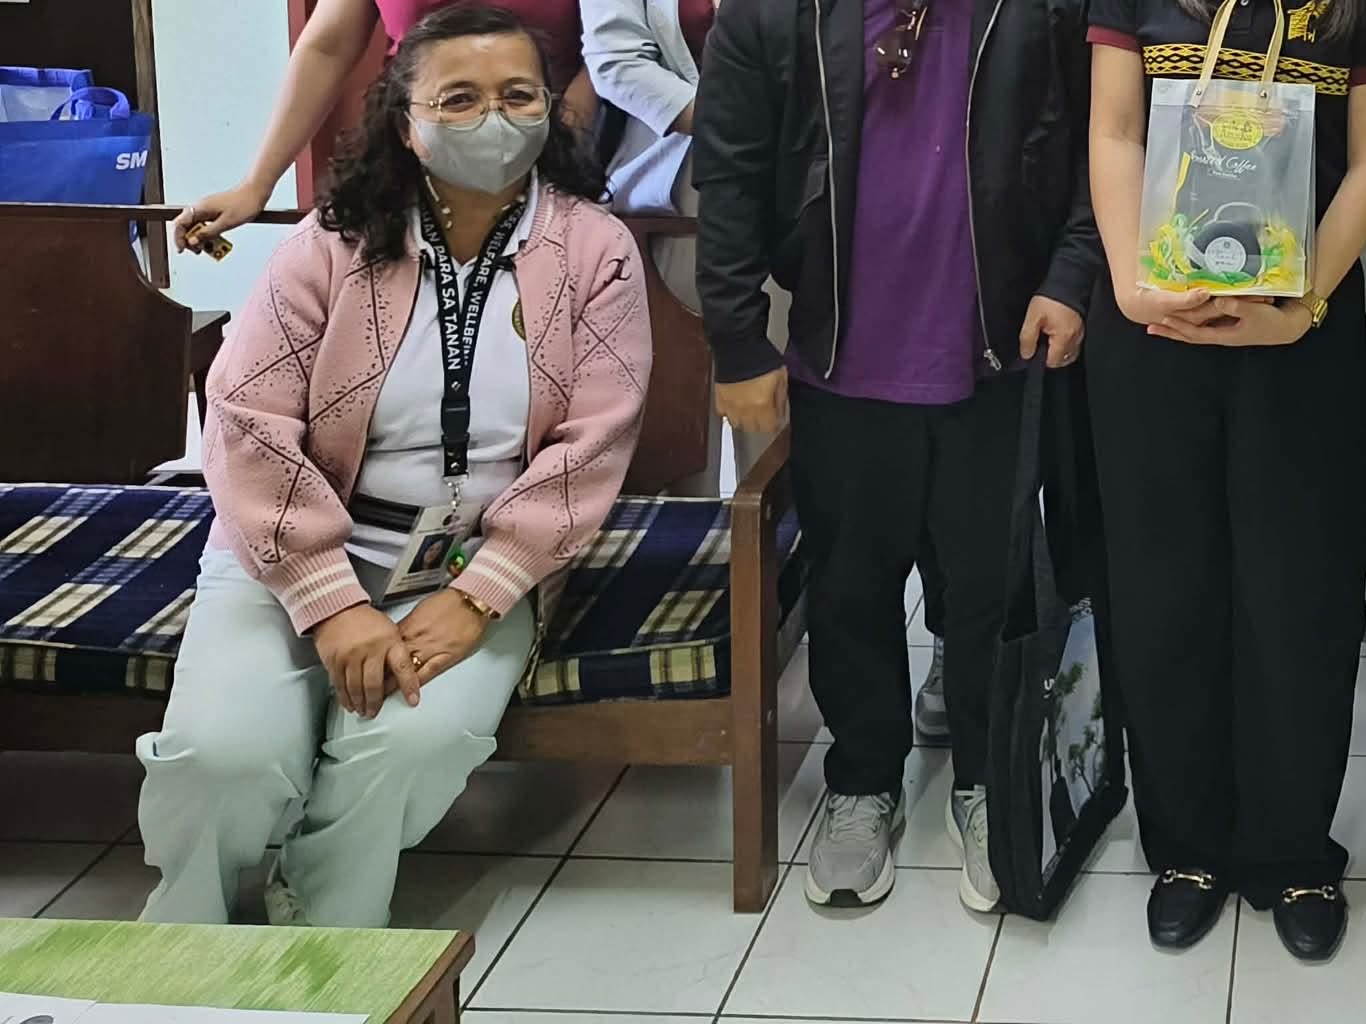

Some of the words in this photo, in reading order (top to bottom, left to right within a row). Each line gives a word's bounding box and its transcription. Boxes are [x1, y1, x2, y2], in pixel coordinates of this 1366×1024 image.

[115, 150, 148, 170] SM
[433, 245, 454, 285] PARA
[442, 287, 457, 310] SA
[444, 312, 462, 370] TANAN
[462, 290, 484, 367] WELLBEI
